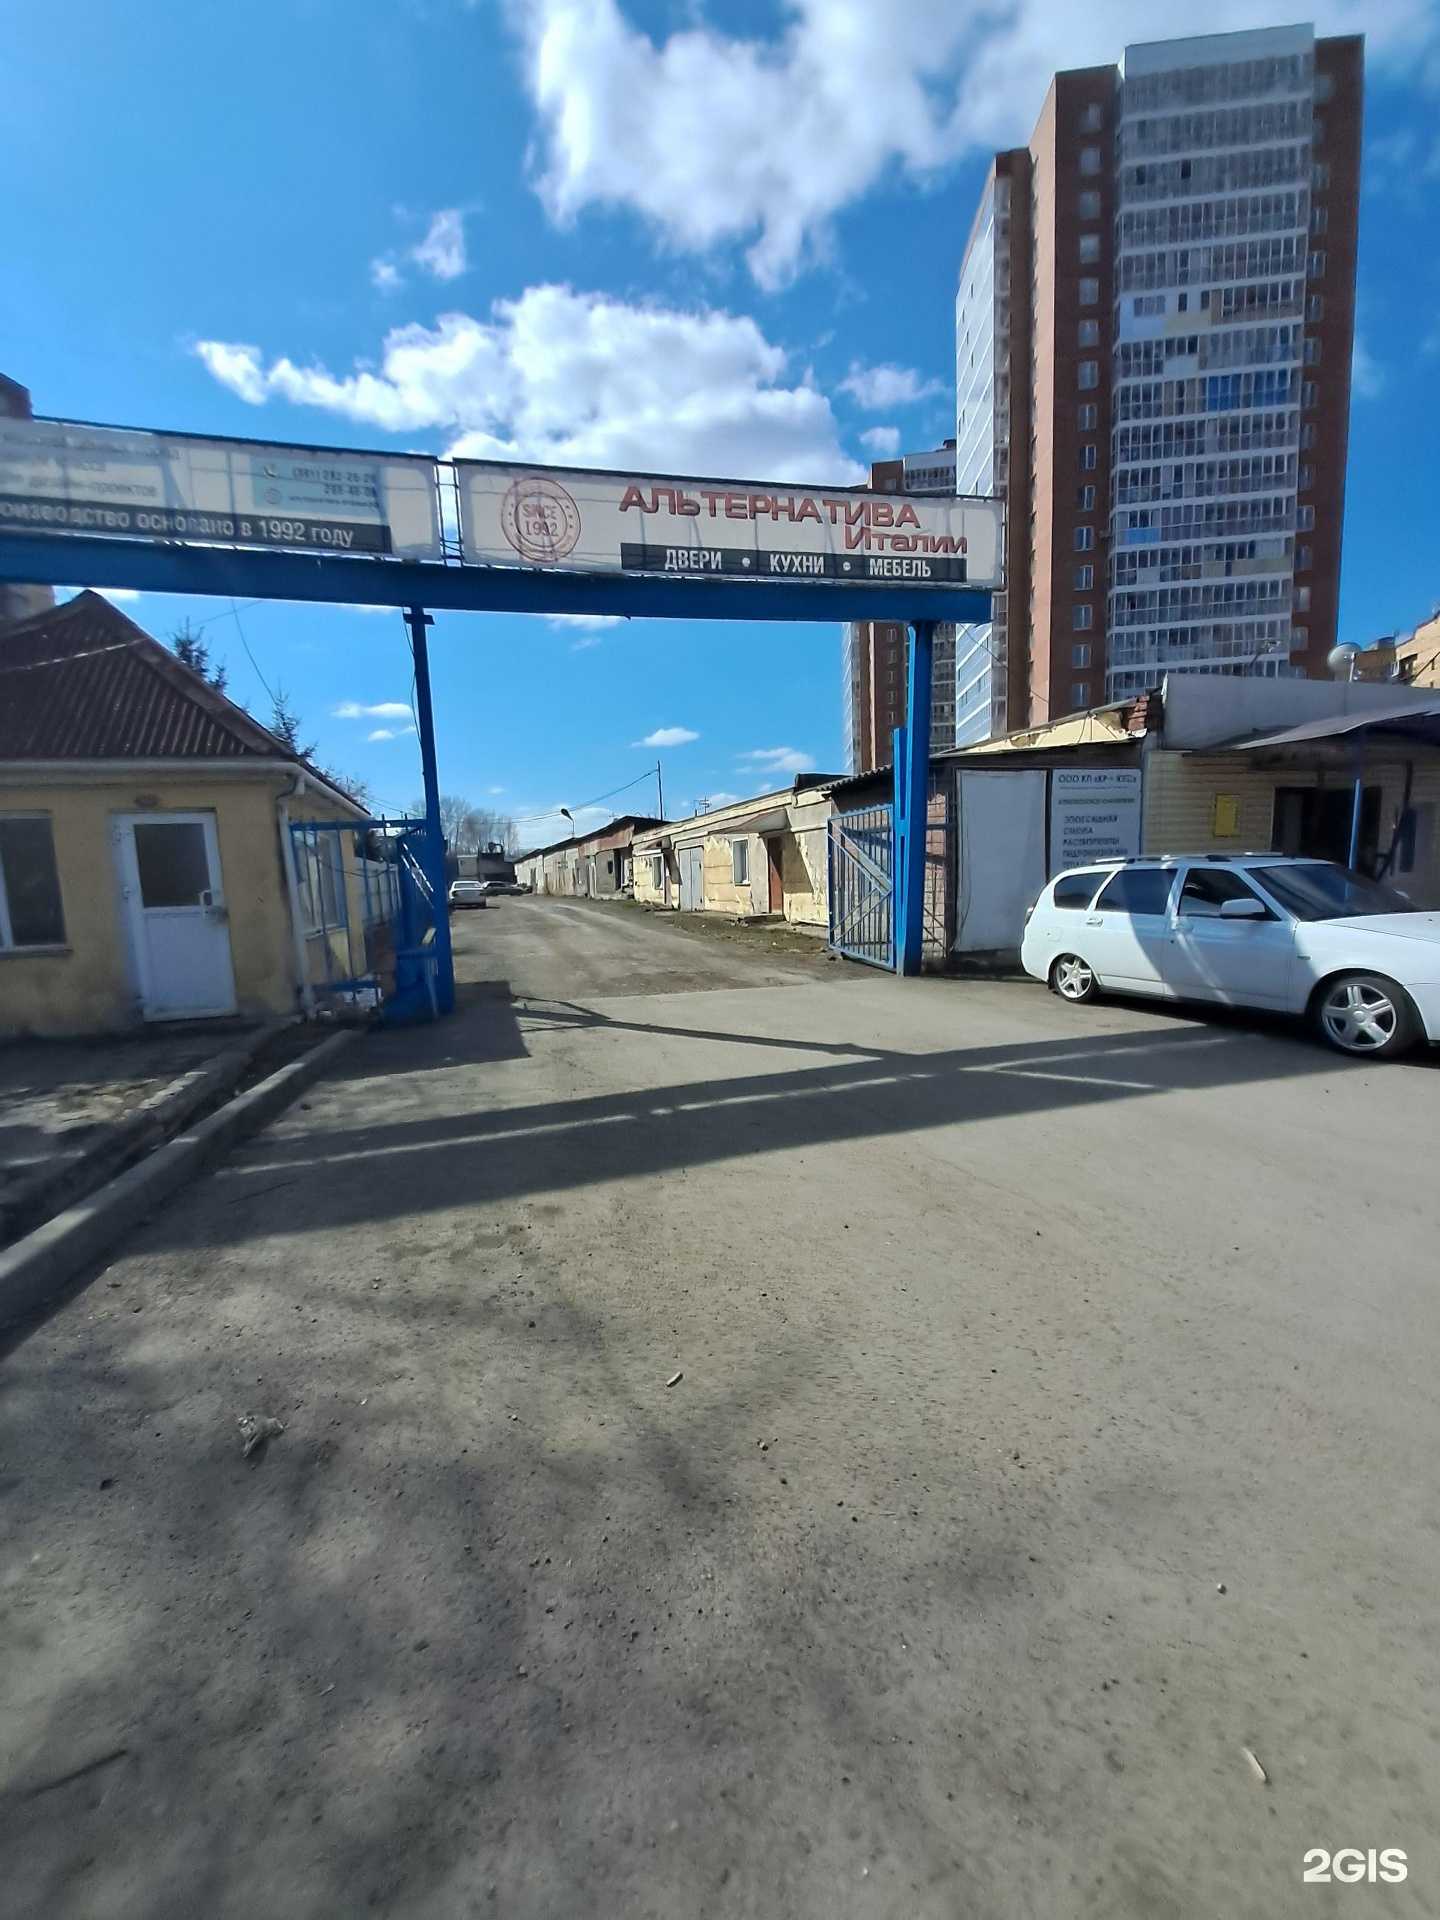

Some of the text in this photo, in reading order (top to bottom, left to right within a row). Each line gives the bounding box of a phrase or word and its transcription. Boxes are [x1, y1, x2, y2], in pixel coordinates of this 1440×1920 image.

[619, 486, 921, 529] АЛЬТЕРНАТИВА
[259, 519, 307, 541] 1992
[311, 526, 354, 548] году
[844, 525, 968, 554] Италии
[664, 548, 931, 578] ДВЕРИ КУХНИ МЕБЕЛЬ
